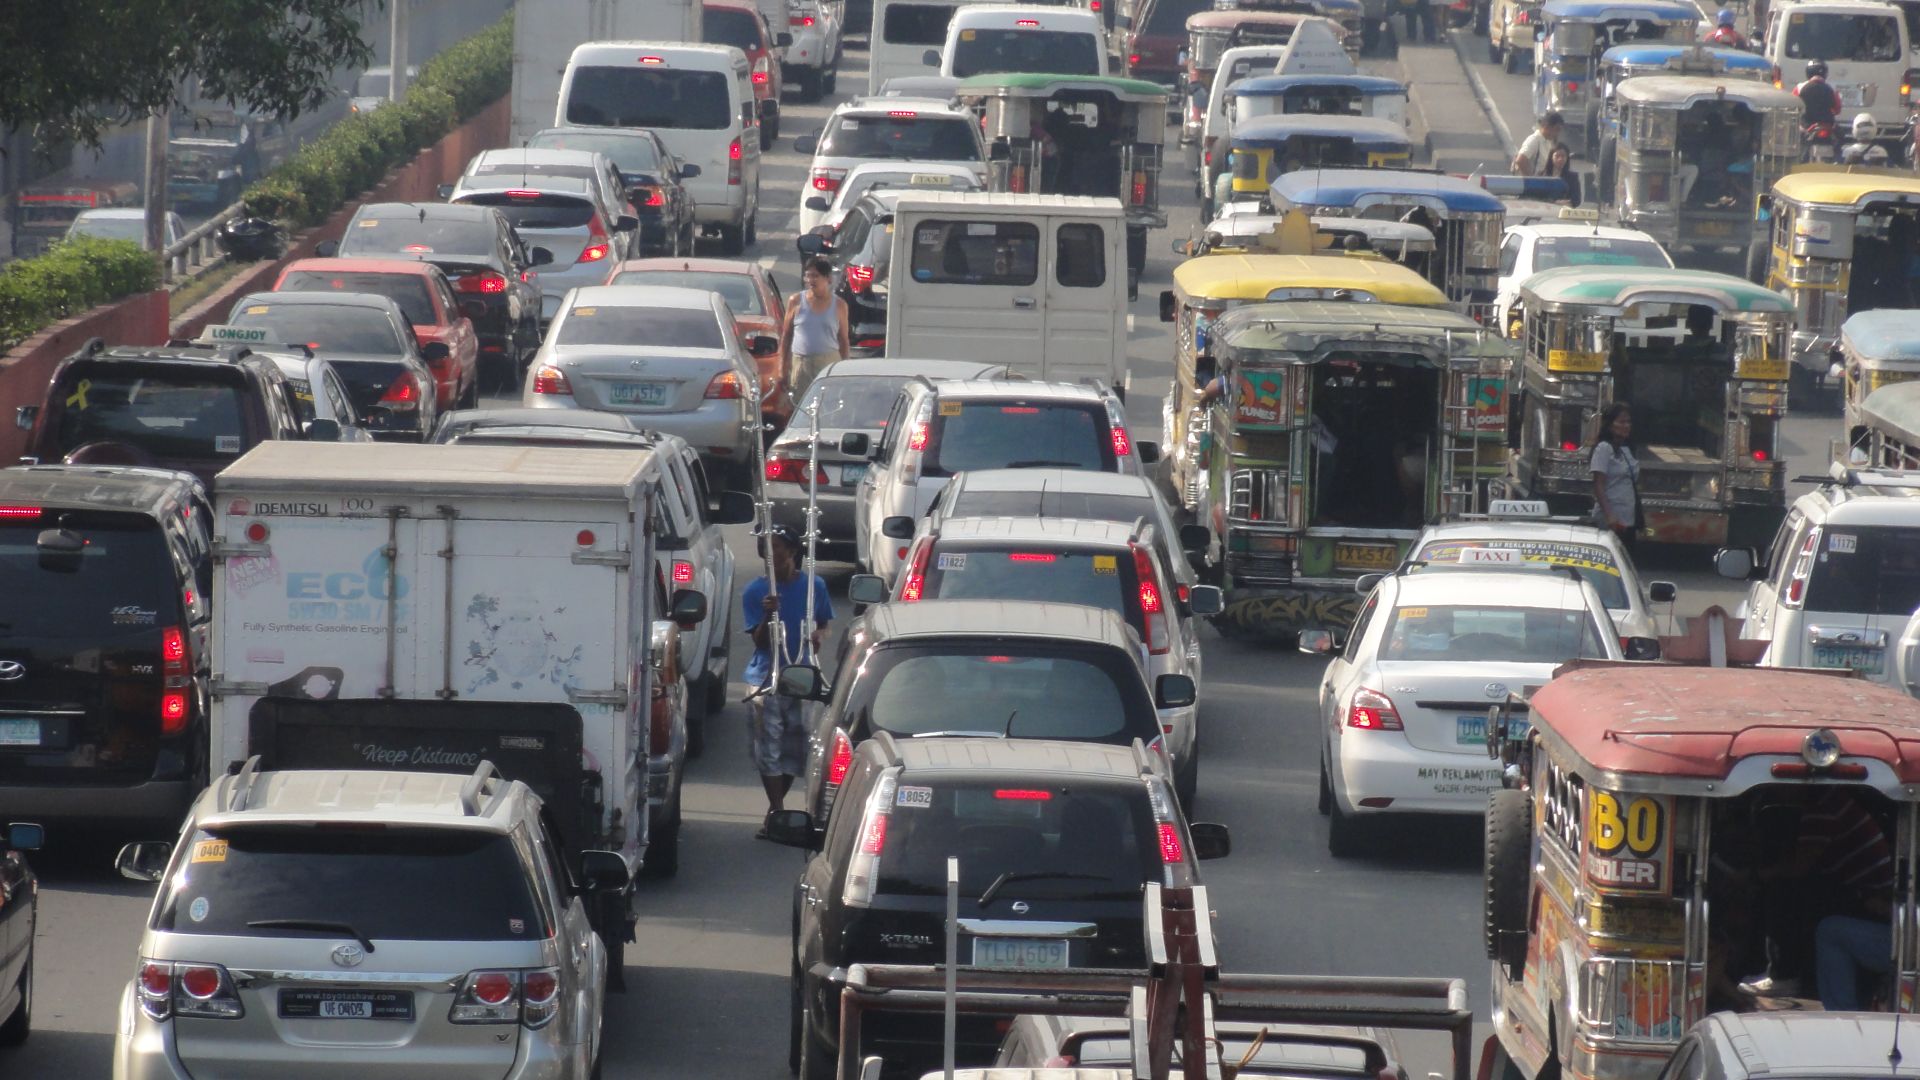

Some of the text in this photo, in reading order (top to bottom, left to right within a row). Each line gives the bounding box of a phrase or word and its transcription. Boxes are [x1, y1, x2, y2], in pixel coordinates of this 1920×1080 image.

[920, 175, 944, 183] TAXI
[1566, 209, 1594, 217] TAXI
[211, 328, 267, 341] LONGJOY
[255, 502, 329, 515] IDEMITSU
[1499, 503, 1540, 513] TAXI
[1473, 551, 1511, 562] TAXI
[230, 556, 272, 579] NEW
[286, 564, 410, 600] ECO
[243, 622, 408, 635] Fully Synthetic Gasoline Engin oil
[1417, 767, 1440, 779] MAY
[906, 790, 931, 804] 8052
[200, 845, 226, 857] 0403
[879, 933, 934, 945] X-TRAIL
[1026, 943, 1061, 964] 609
